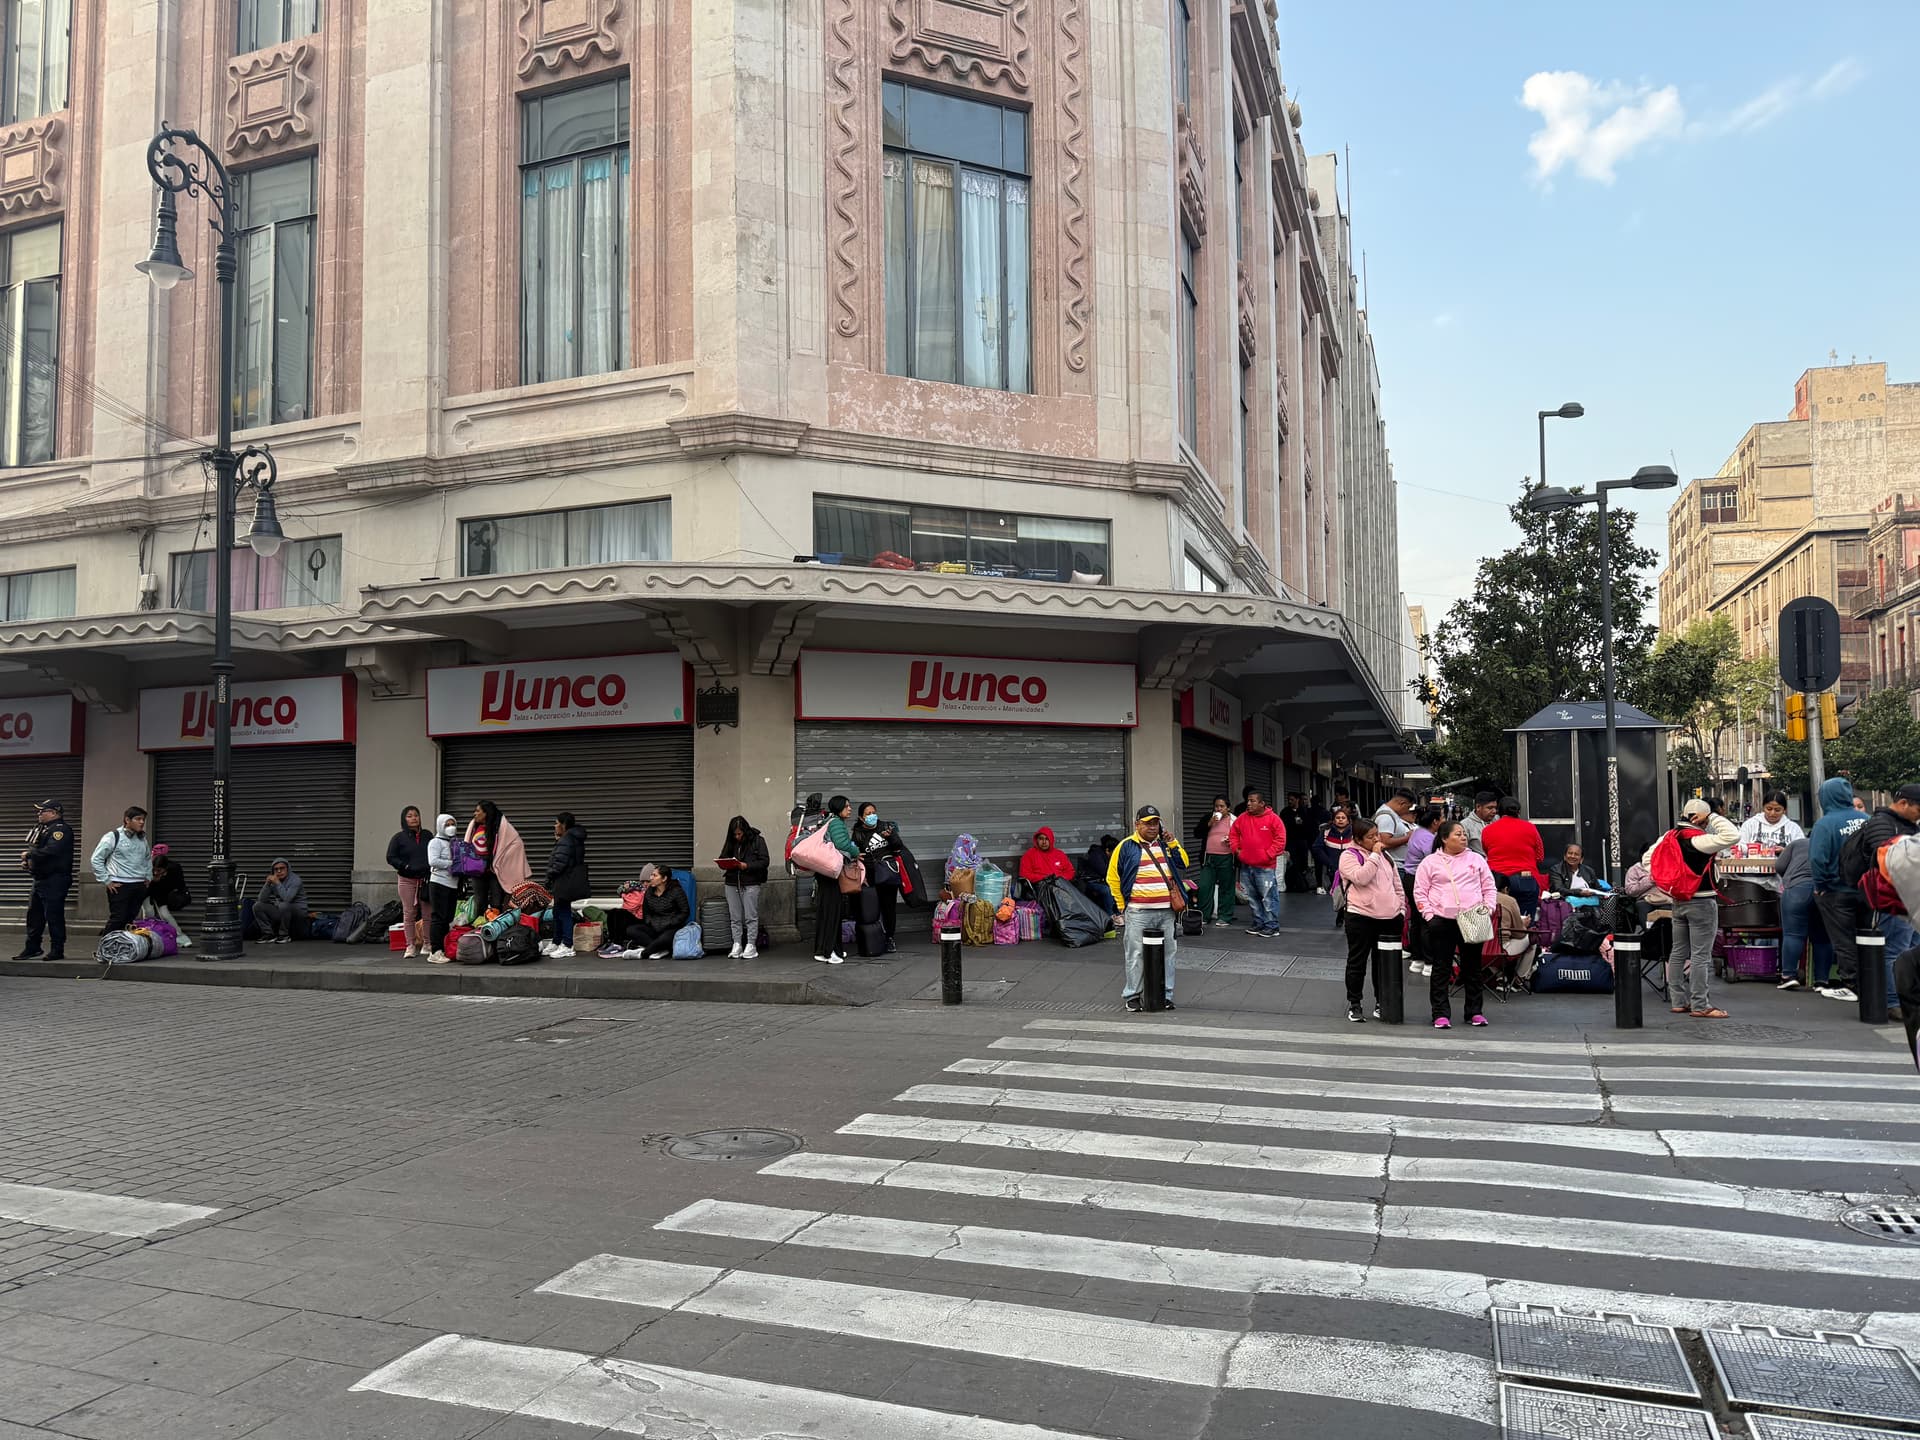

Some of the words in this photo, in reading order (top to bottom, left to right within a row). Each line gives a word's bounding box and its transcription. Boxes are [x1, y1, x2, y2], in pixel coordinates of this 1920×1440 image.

[908, 661, 1047, 707] Junco
[481, 670, 626, 721] Junco
[534, 712, 570, 720] Decoración
[577, 709, 622, 718] Manualidades
[962, 703, 997, 711] Decoración
[1003, 705, 1044, 713] Manualidades
[1558, 968, 1591, 981] PUMA
[1548, 1417, 1655, 1440] OTABLE
